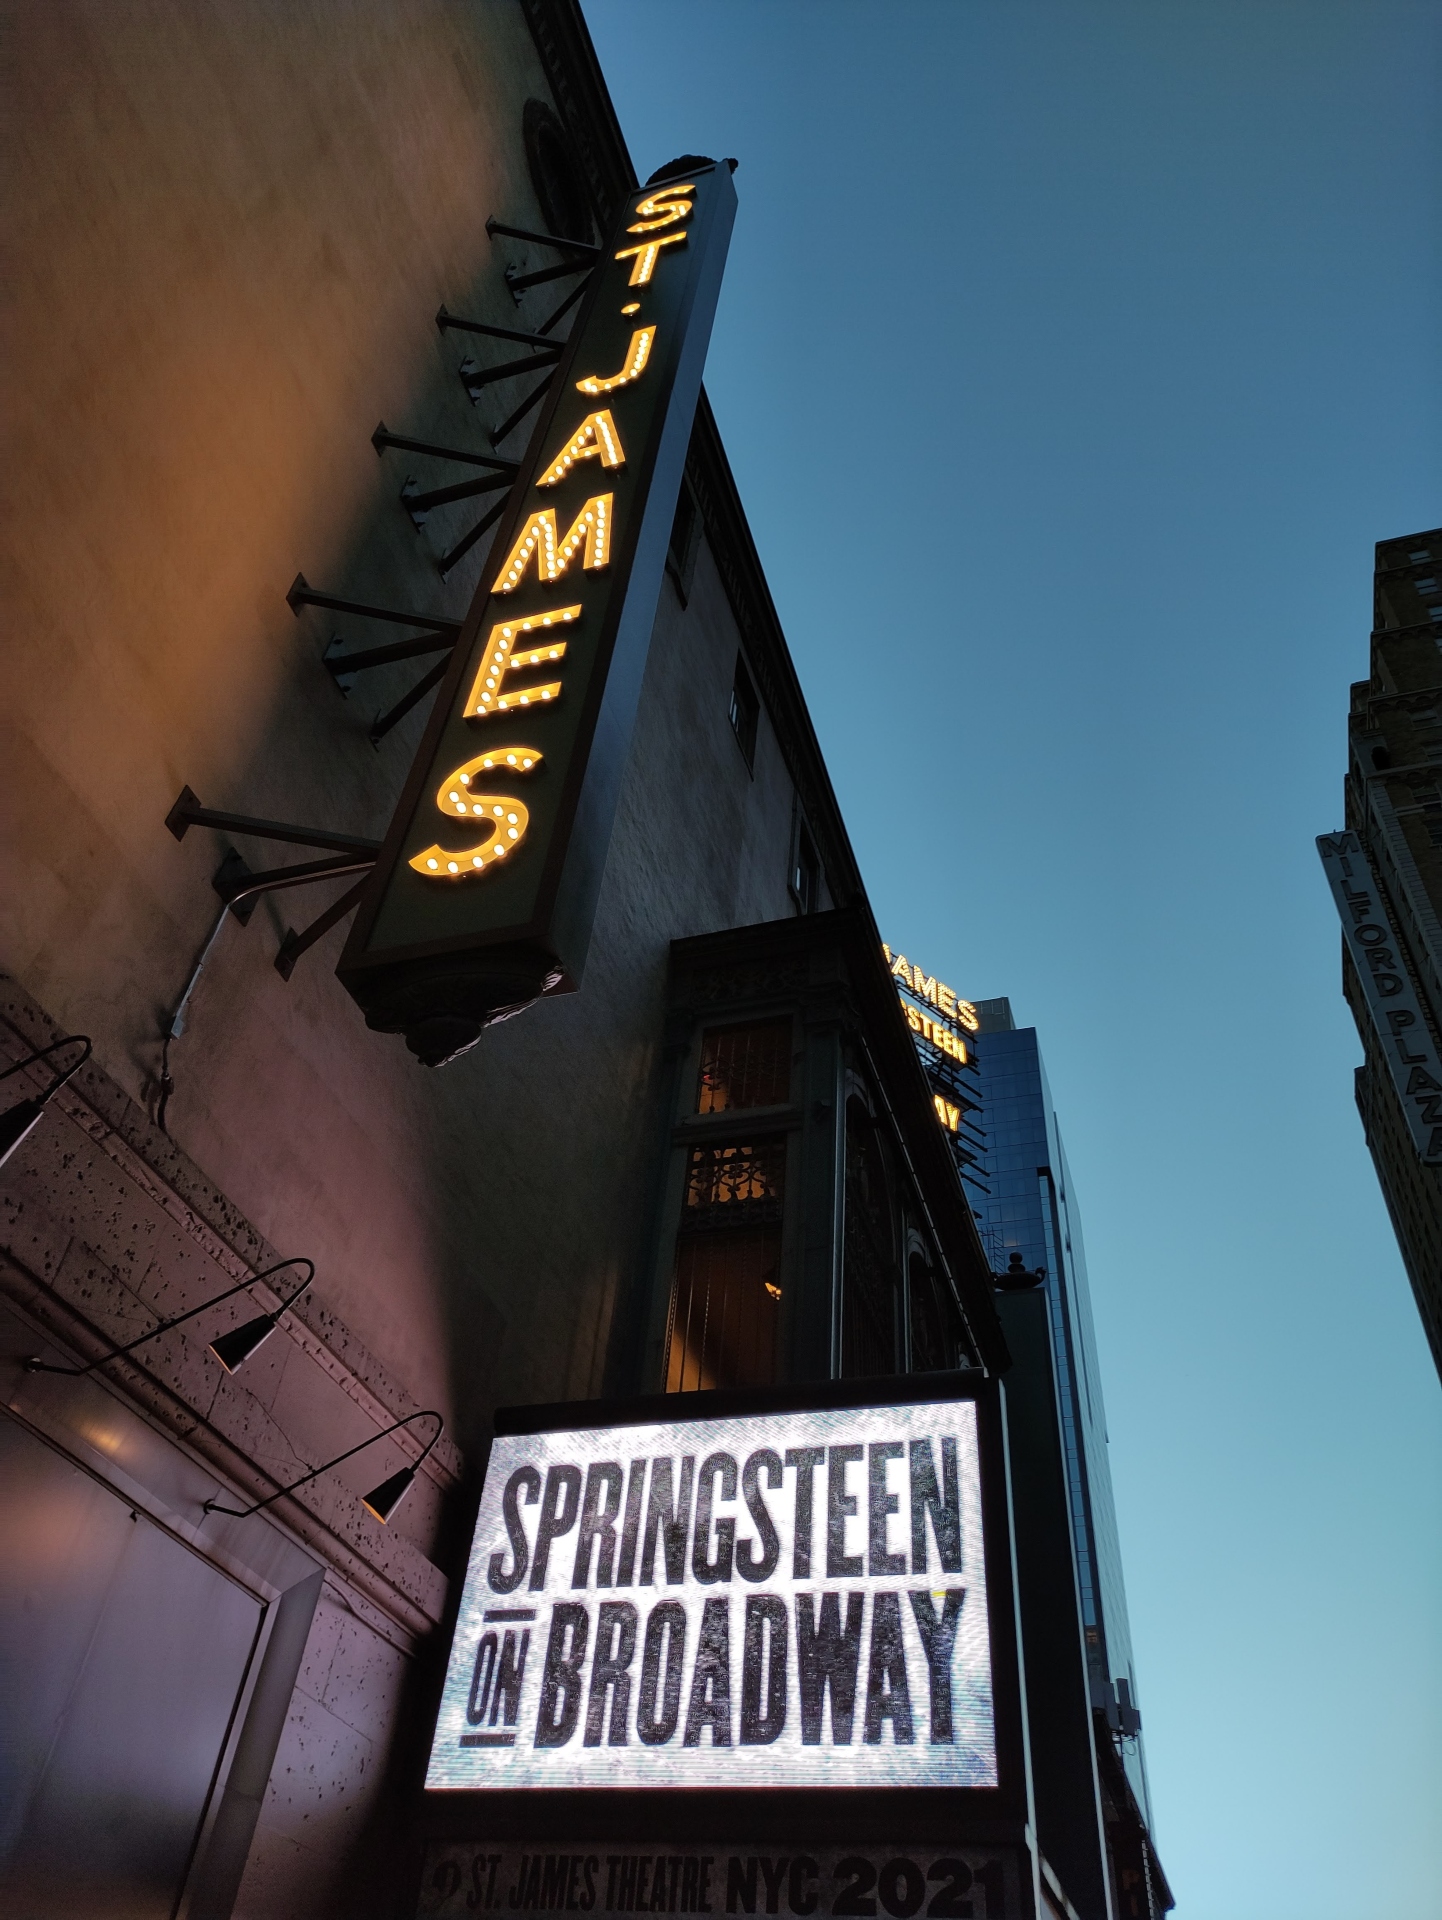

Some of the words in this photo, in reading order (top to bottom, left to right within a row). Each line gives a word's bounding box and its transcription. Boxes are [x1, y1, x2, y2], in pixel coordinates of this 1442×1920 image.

[408, 325, 657, 877] JAMES
[1319, 832, 1404, 998] MILFORD
[489, 1438, 962, 1595] SPRINGSTEEN
[466, 1628, 531, 1727] ON
[533, 1589, 966, 1749] BROADWAY
[466, 1854, 502, 1910] ST.
[508, 1854, 600, 1911] JAMES
[605, 1855, 715, 1913] THEATRE
[726, 1855, 820, 1916] NYC
[831, 1855, 1005, 1920] 2021
